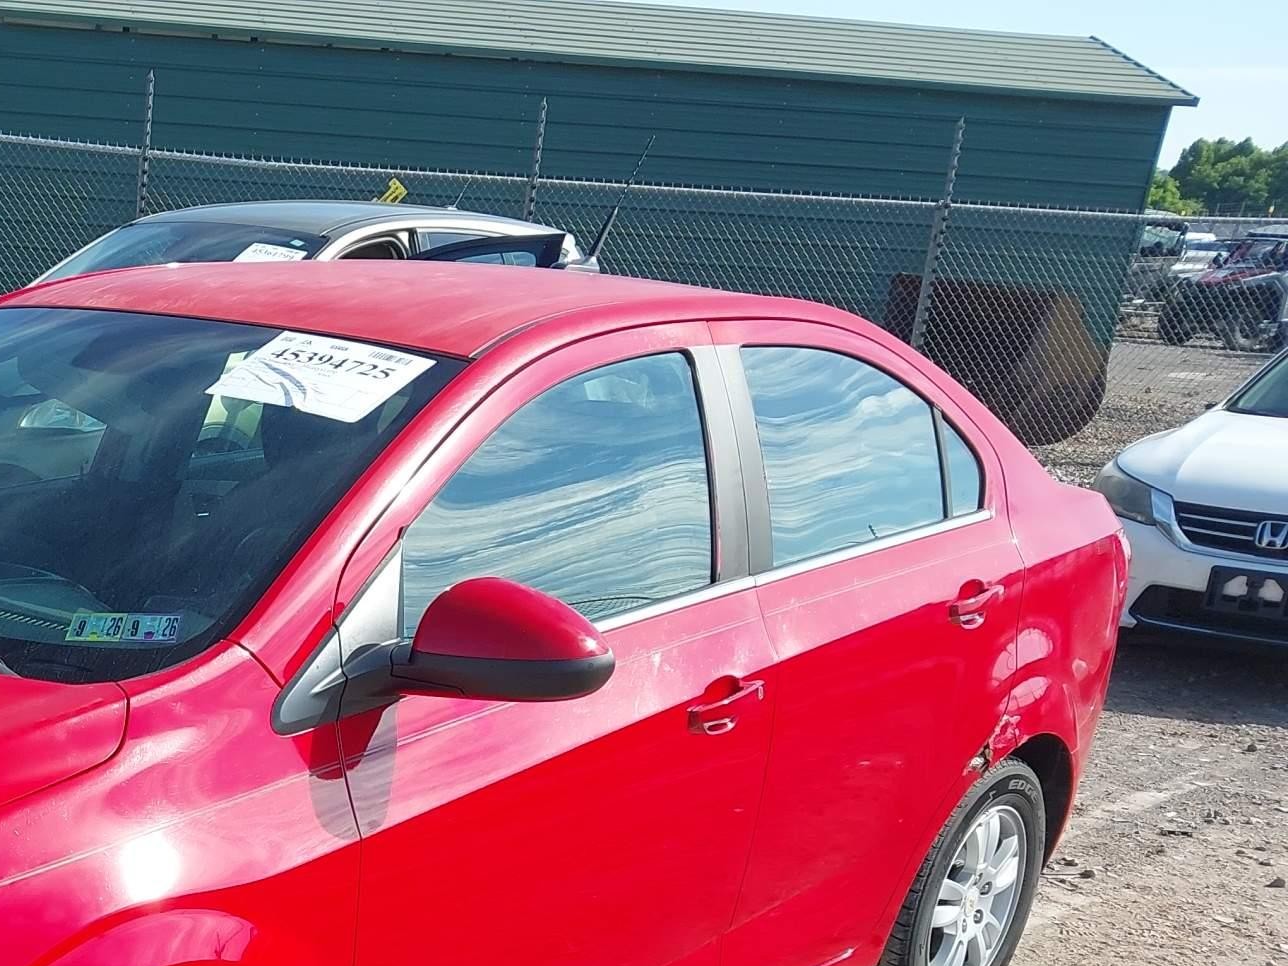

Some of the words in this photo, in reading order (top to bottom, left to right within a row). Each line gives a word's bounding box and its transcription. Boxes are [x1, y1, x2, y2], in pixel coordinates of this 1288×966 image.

[271, 347, 397, 380] 45394725
[76, 620, 87, 637] 9
[130, 619, 140, 637] 9
[1008, 780, 1038, 804] EDGE
